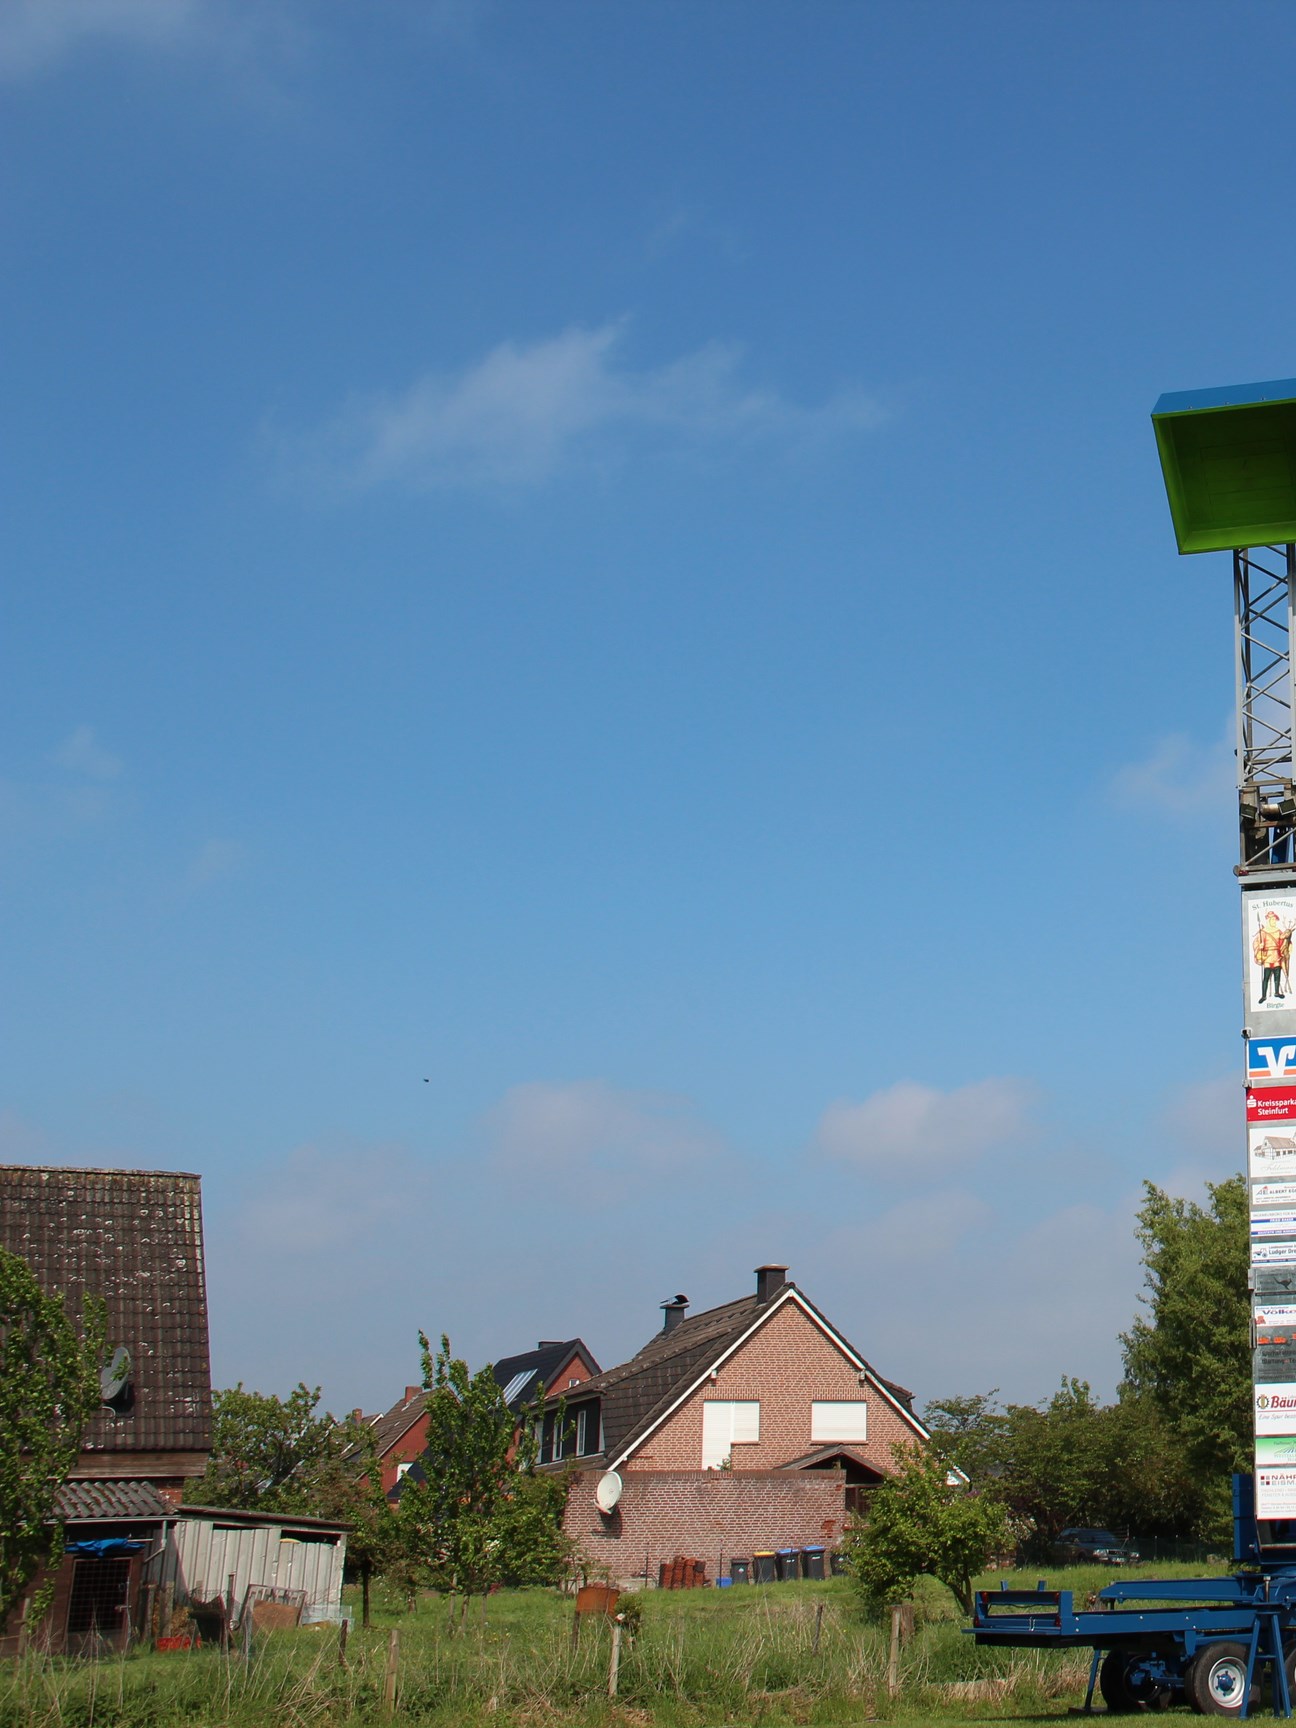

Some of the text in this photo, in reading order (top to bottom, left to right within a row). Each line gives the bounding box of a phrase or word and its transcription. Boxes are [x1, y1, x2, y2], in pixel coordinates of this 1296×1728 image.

[1262, 900, 1294, 908] Hubertus
[1257, 1107, 1289, 1116] Steinfurt
[1271, 1413, 1283, 1421] Spur
